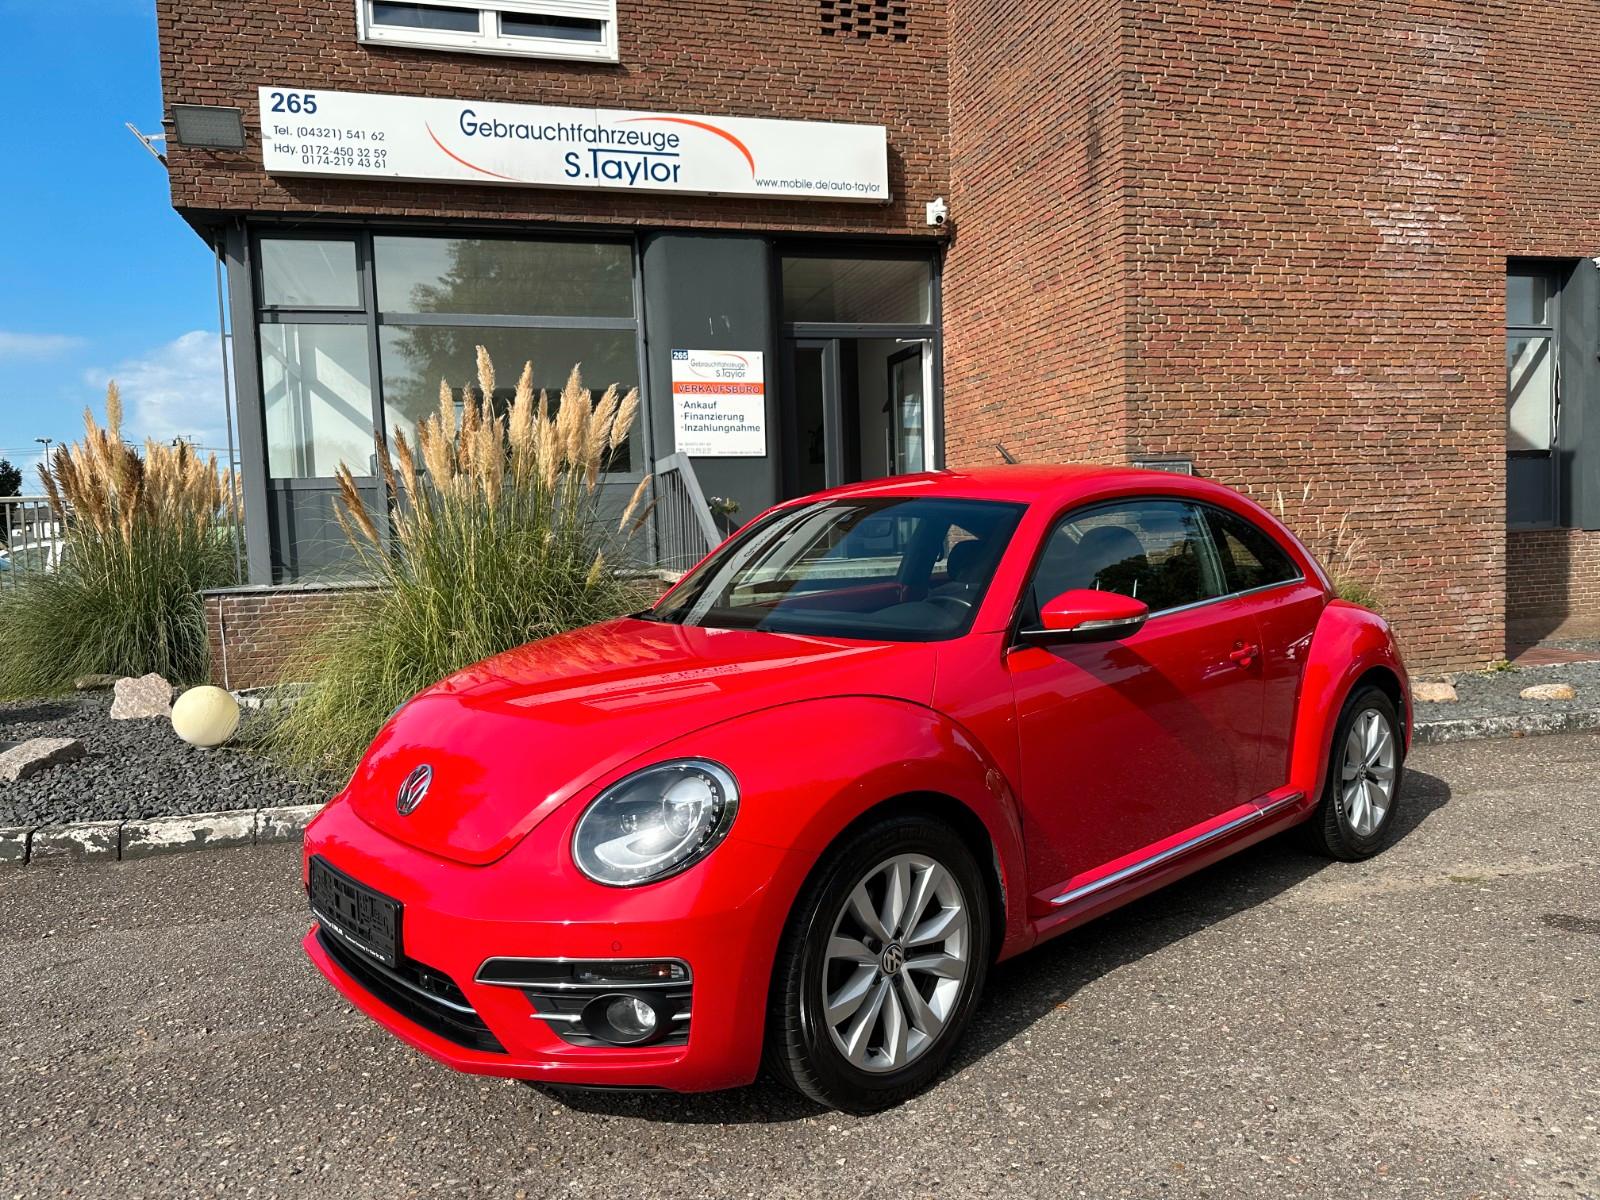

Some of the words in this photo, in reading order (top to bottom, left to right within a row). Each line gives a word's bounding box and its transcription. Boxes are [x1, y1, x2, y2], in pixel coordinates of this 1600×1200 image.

[270, 91, 317, 114] 265
[273, 125, 293, 136] Tel.
[296, 126, 342, 141] (04321)
[346, 129, 366, 140] 541
[370, 131, 385, 141] 62
[460, 109, 680, 151] Gebrauchtfahrzeuge
[274, 143, 298, 155] Hdy.
[301, 144, 354, 157] 0172-450
[357, 148, 370, 158] 32
[373, 148, 387, 159] 59
[302, 154, 354, 167] 0174-219
[357, 158, 371, 168] 43
[374, 159, 386, 168] 61
[564, 148, 680, 186] S.Taylor
[755, 178, 880, 193] www.mobile.de/auto-taylor
[673, 351, 688, 360] 265
[683, 401, 717, 409] Ankauf
[684, 412, 745, 422] Finanzierung
[684, 424, 761, 434] Inzahlungnahme
